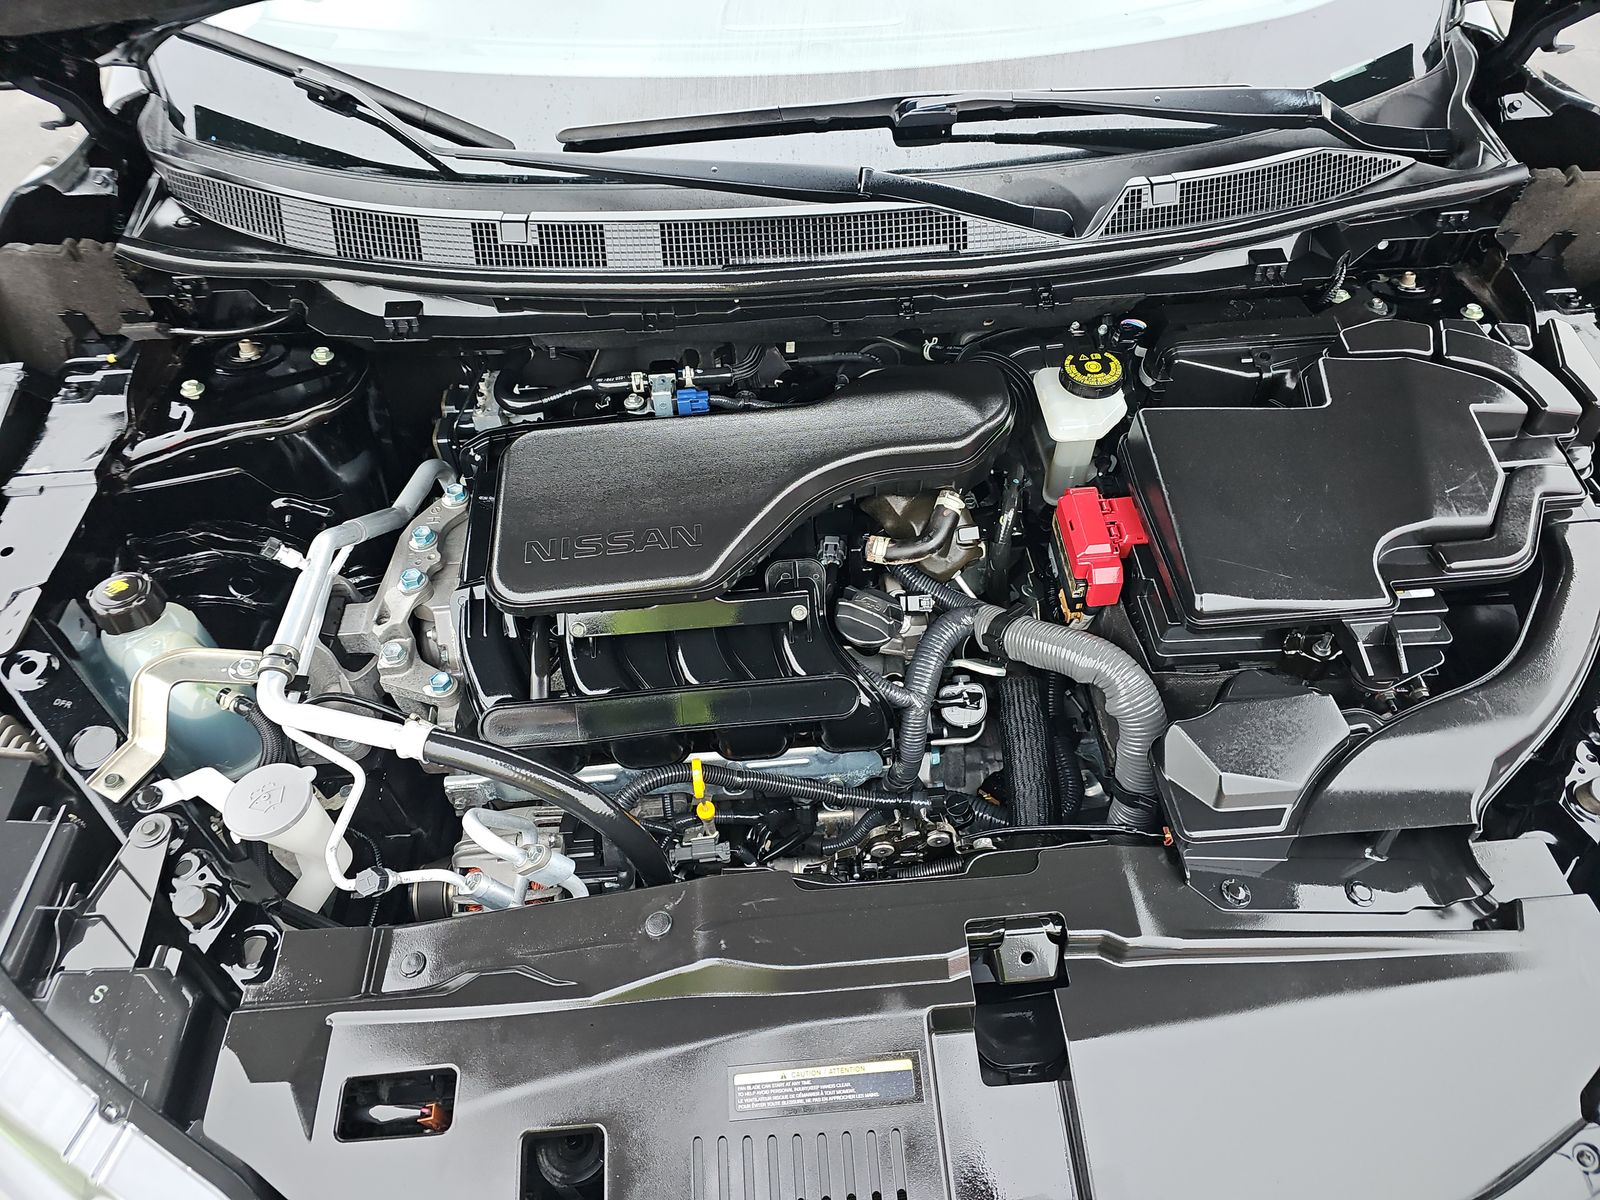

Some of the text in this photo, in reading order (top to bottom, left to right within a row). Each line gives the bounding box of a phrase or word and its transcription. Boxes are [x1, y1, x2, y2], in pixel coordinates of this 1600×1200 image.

[524, 523, 703, 564] NISSAN
[88, 984, 109, 1004] S
[792, 1070, 822, 1078] CAUTION
[828, 1066, 865, 1074] ATTENTION
